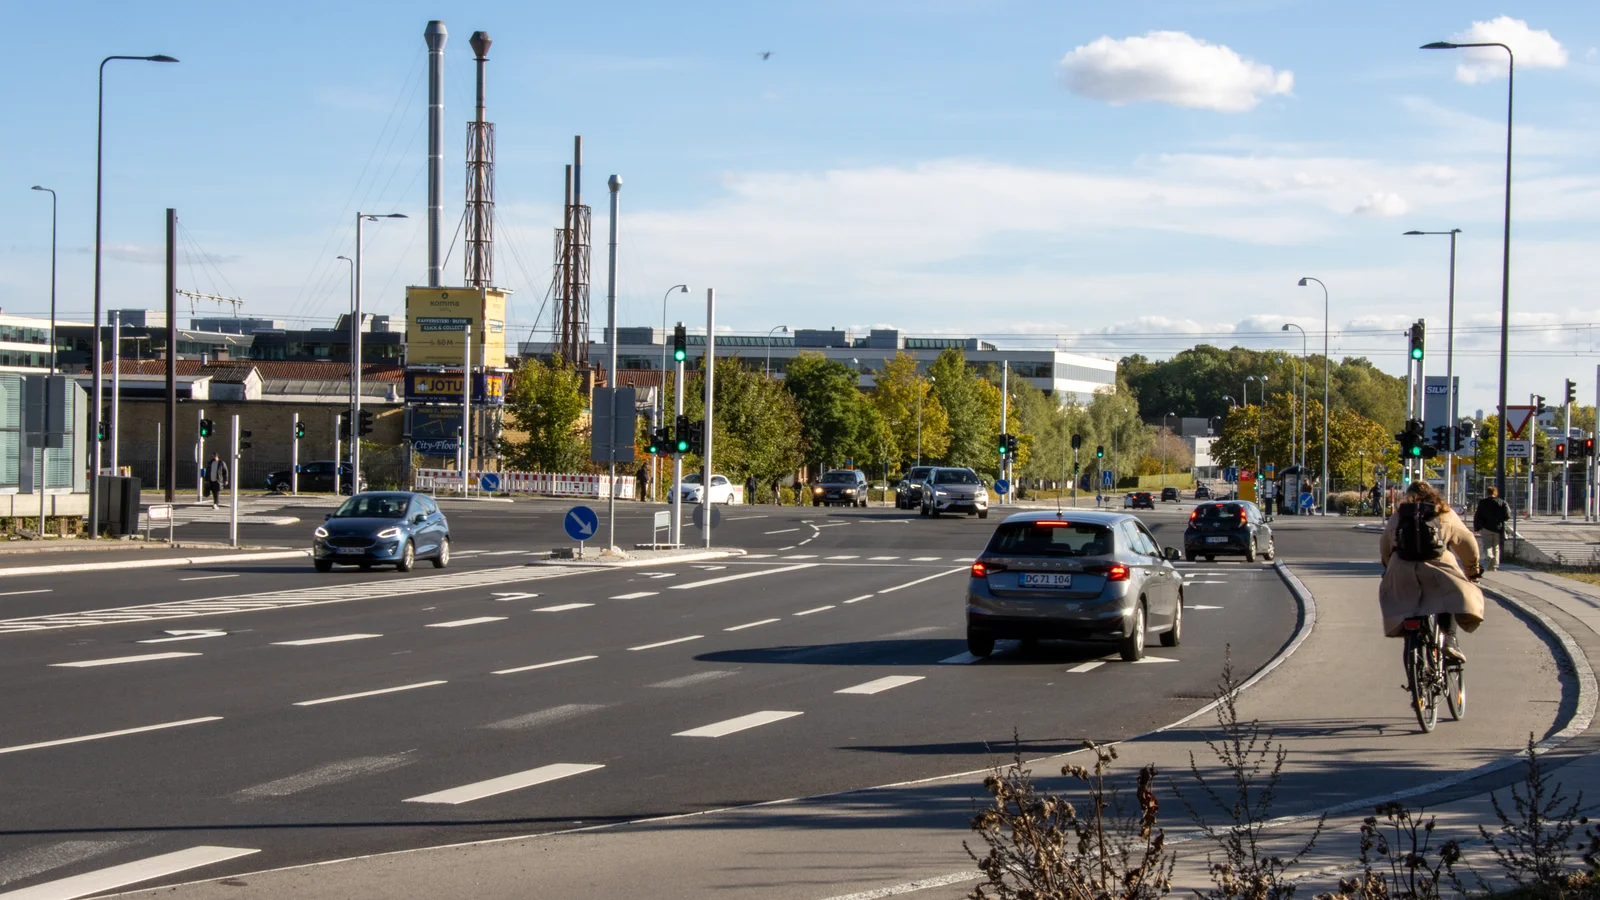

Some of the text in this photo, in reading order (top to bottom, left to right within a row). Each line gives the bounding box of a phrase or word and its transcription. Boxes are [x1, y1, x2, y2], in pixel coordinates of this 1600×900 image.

[429, 379, 472, 392] JOTU
[1025, 574, 1070, 584] DG 71 104
